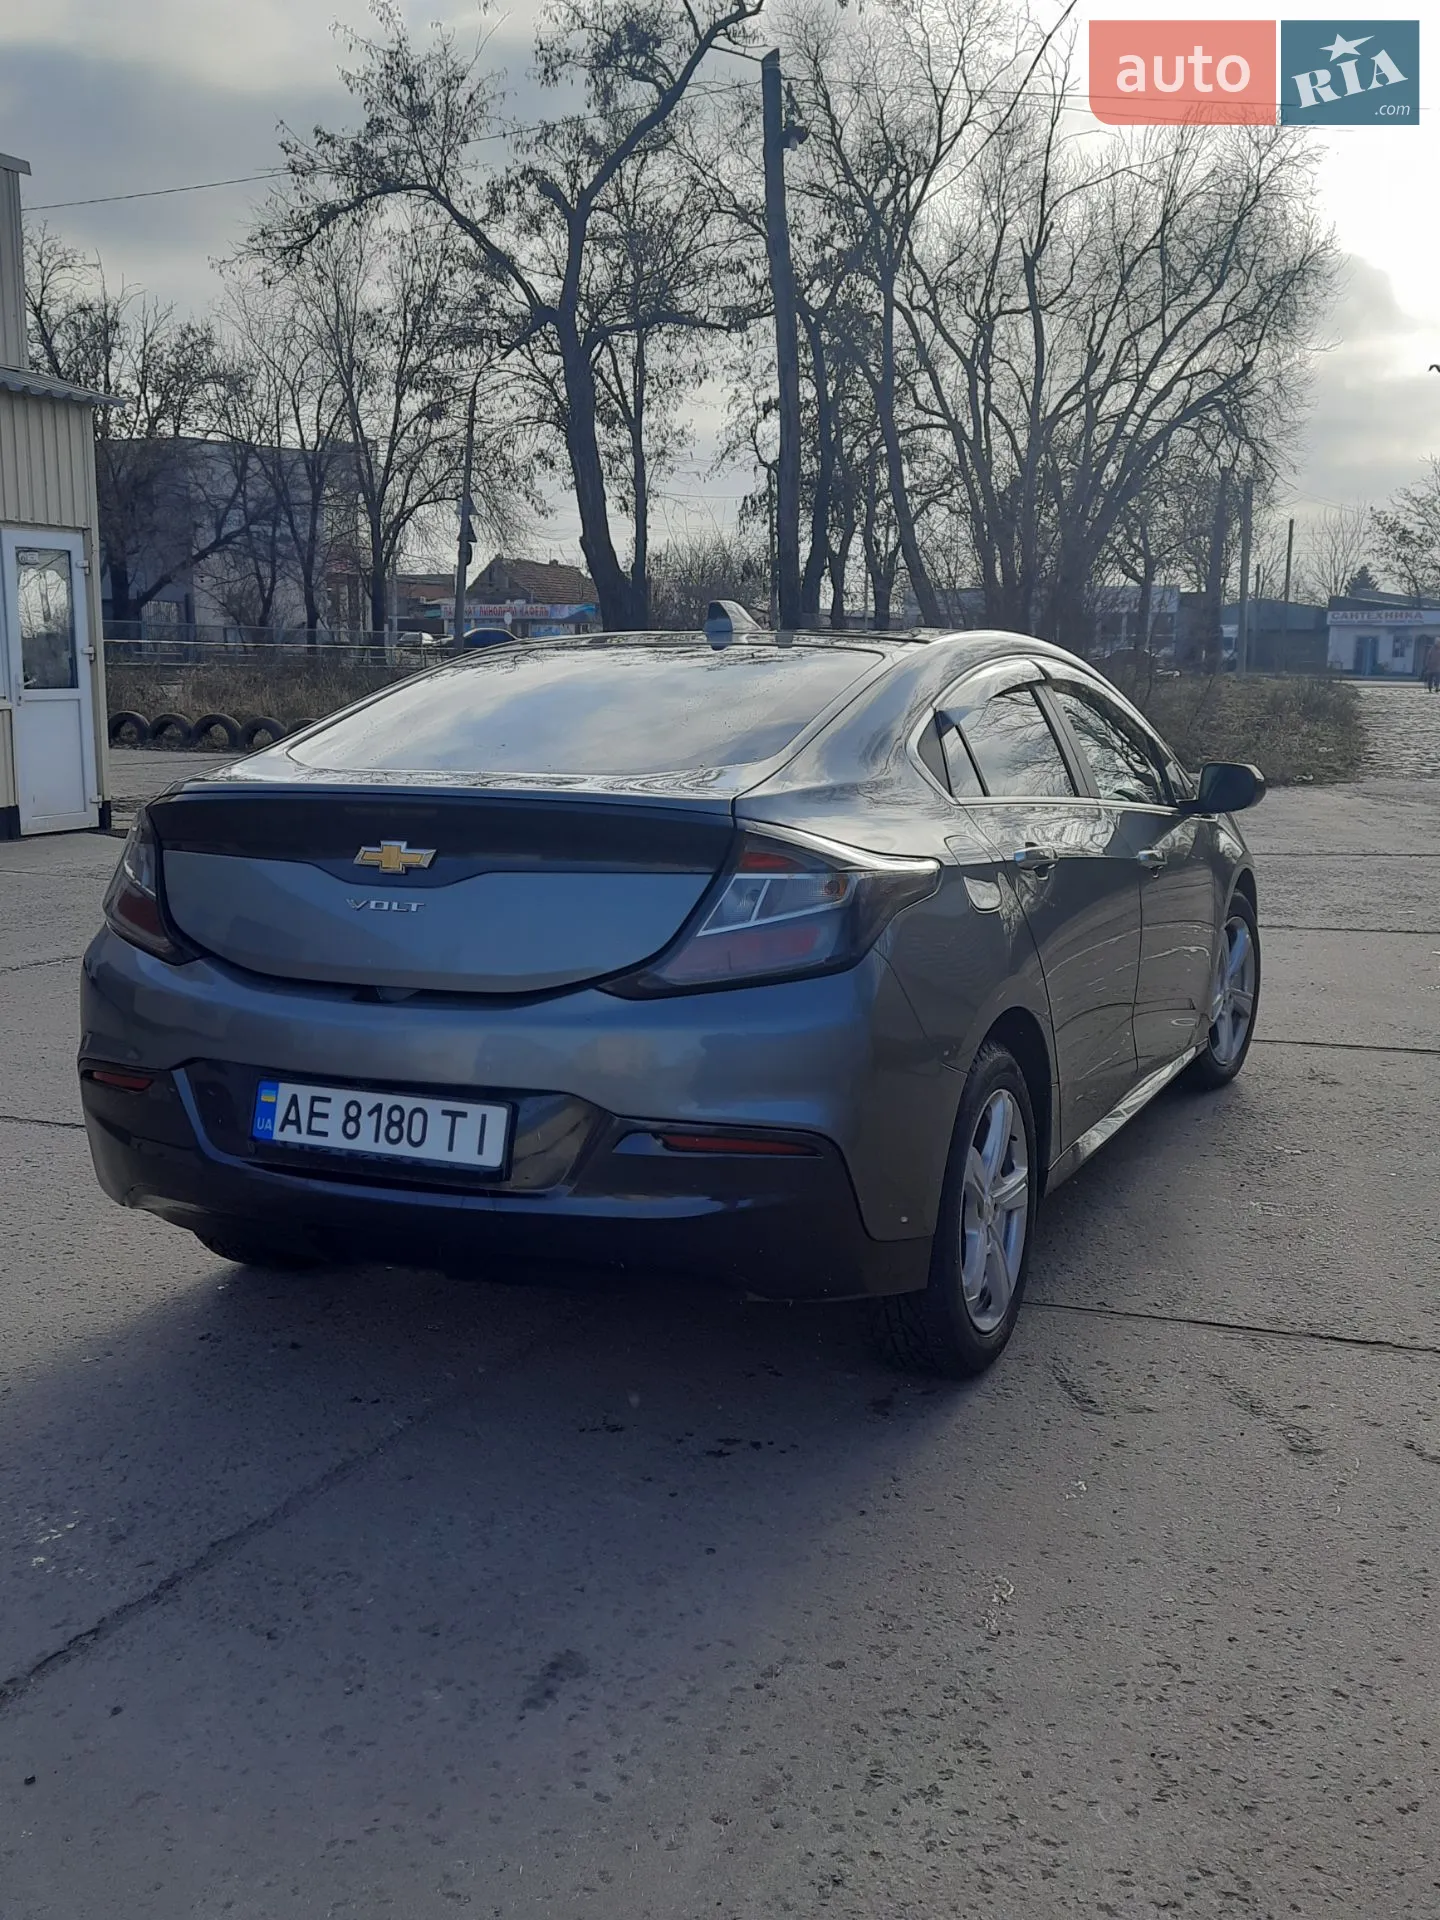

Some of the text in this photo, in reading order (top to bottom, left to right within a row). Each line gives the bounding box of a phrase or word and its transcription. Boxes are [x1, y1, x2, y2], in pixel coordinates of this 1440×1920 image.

[1331, 610, 1424, 620] САНТЕХНИКА
[345, 898, 426, 912] VOLT
[256, 1117, 273, 1132] UA
[278, 1092, 488, 1156] AE 8180 TI
